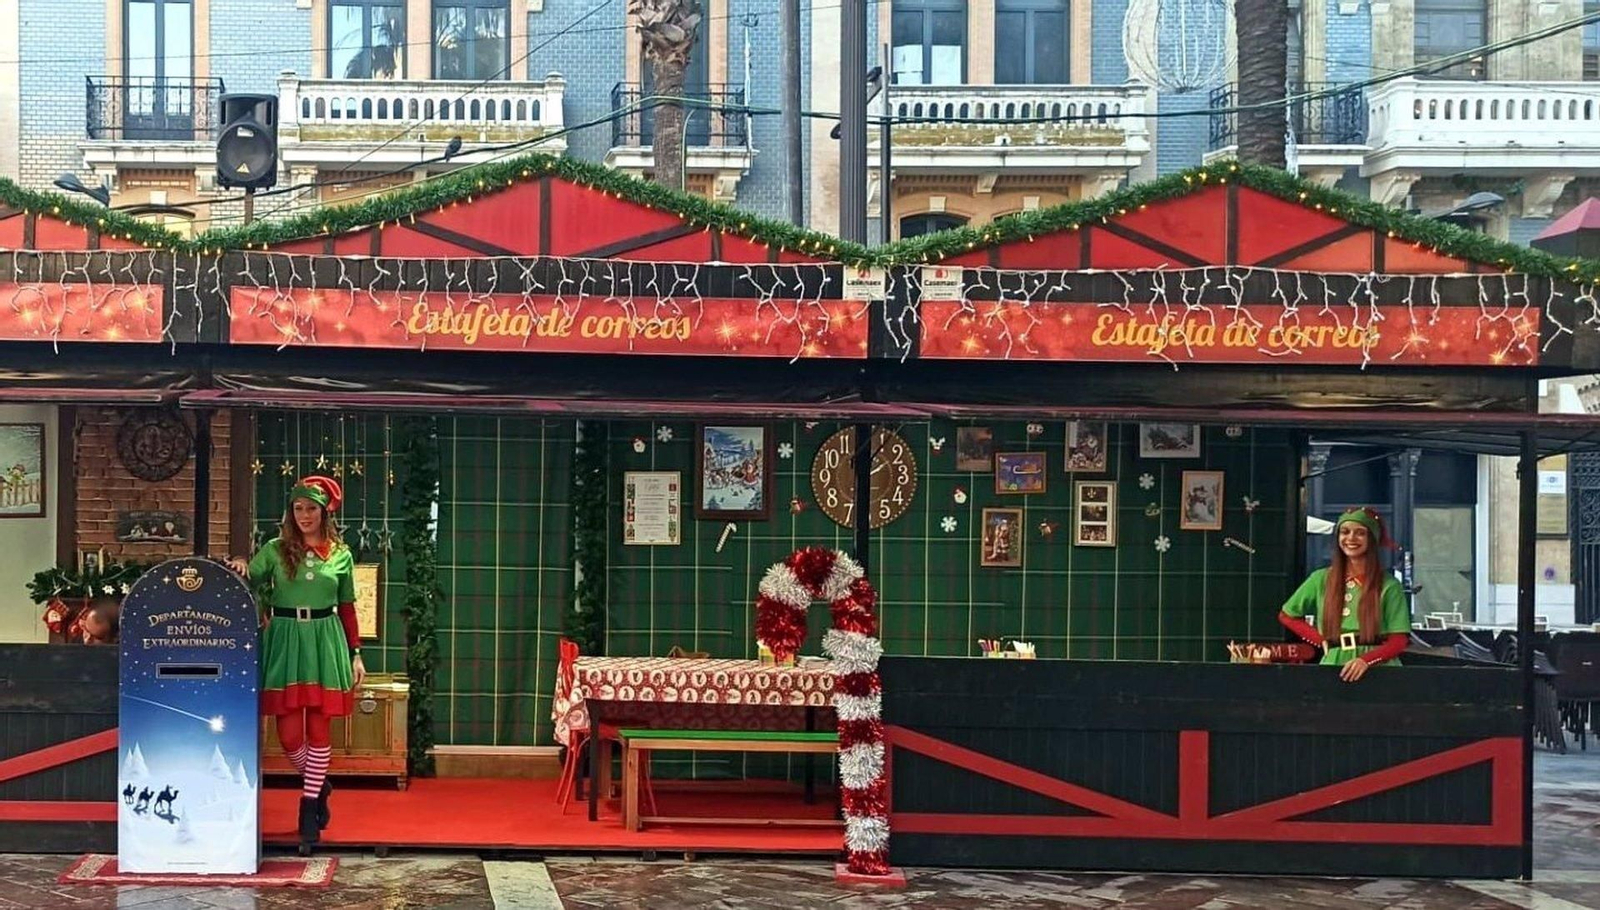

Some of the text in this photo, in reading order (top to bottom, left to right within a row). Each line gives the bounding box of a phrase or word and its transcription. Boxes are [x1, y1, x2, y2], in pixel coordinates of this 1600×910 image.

[407, 303, 691, 345] Estafeta de correos
[1091, 313, 1379, 352] Estafeta de correos
[840, 435, 849, 454] 11
[880, 433, 885, 453] 1
[825, 448, 839, 469] 10
[892, 444, 903, 465] 2
[819, 468, 831, 489] 9
[897, 464, 909, 485] 3
[826, 487, 838, 508] 8
[892, 485, 904, 506] 4
[843, 503, 854, 525] 7
[879, 499, 891, 519] 5
[148, 610, 231, 628] DEPARTAMENTO
[166, 624, 212, 635] ENVÍOS
[142, 638, 237, 650] EXTRAORDINARIOS
